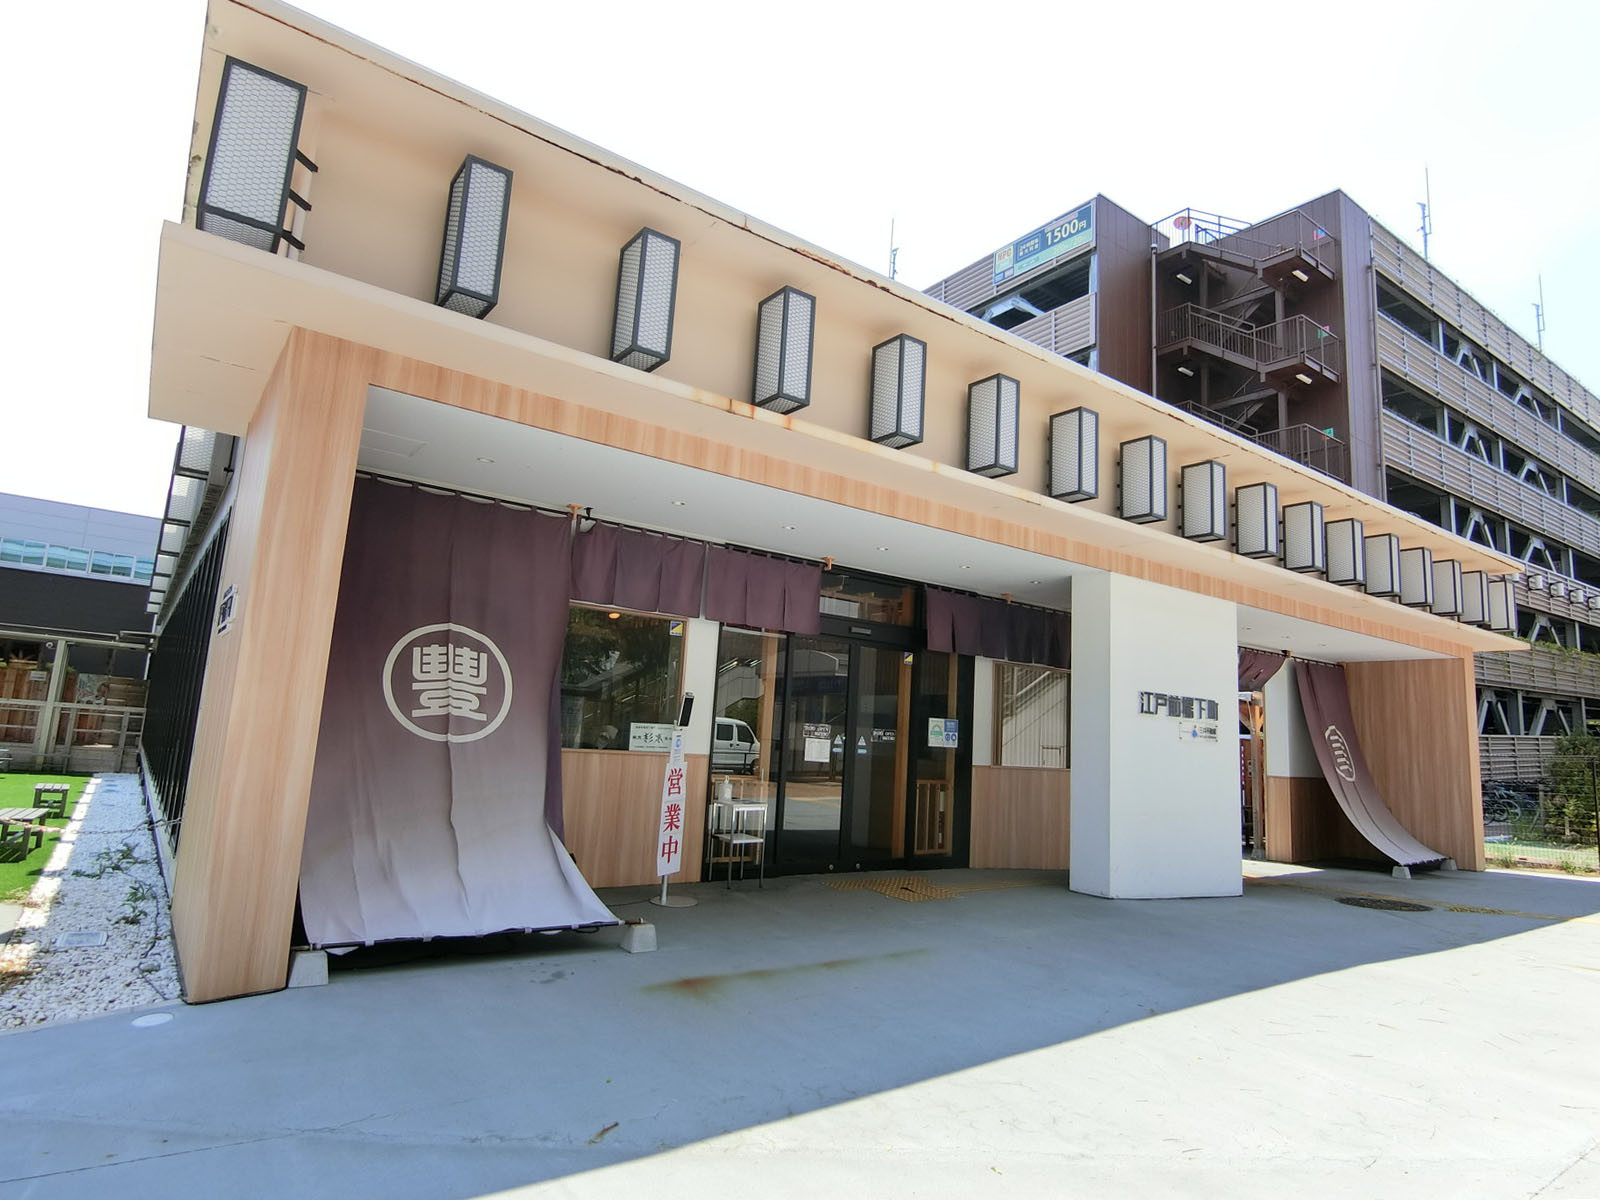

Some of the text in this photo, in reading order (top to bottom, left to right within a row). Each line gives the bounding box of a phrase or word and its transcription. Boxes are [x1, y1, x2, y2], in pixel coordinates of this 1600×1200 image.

[1045, 219, 1087, 246] 1500円
[661, 767, 683, 864] 営業中
